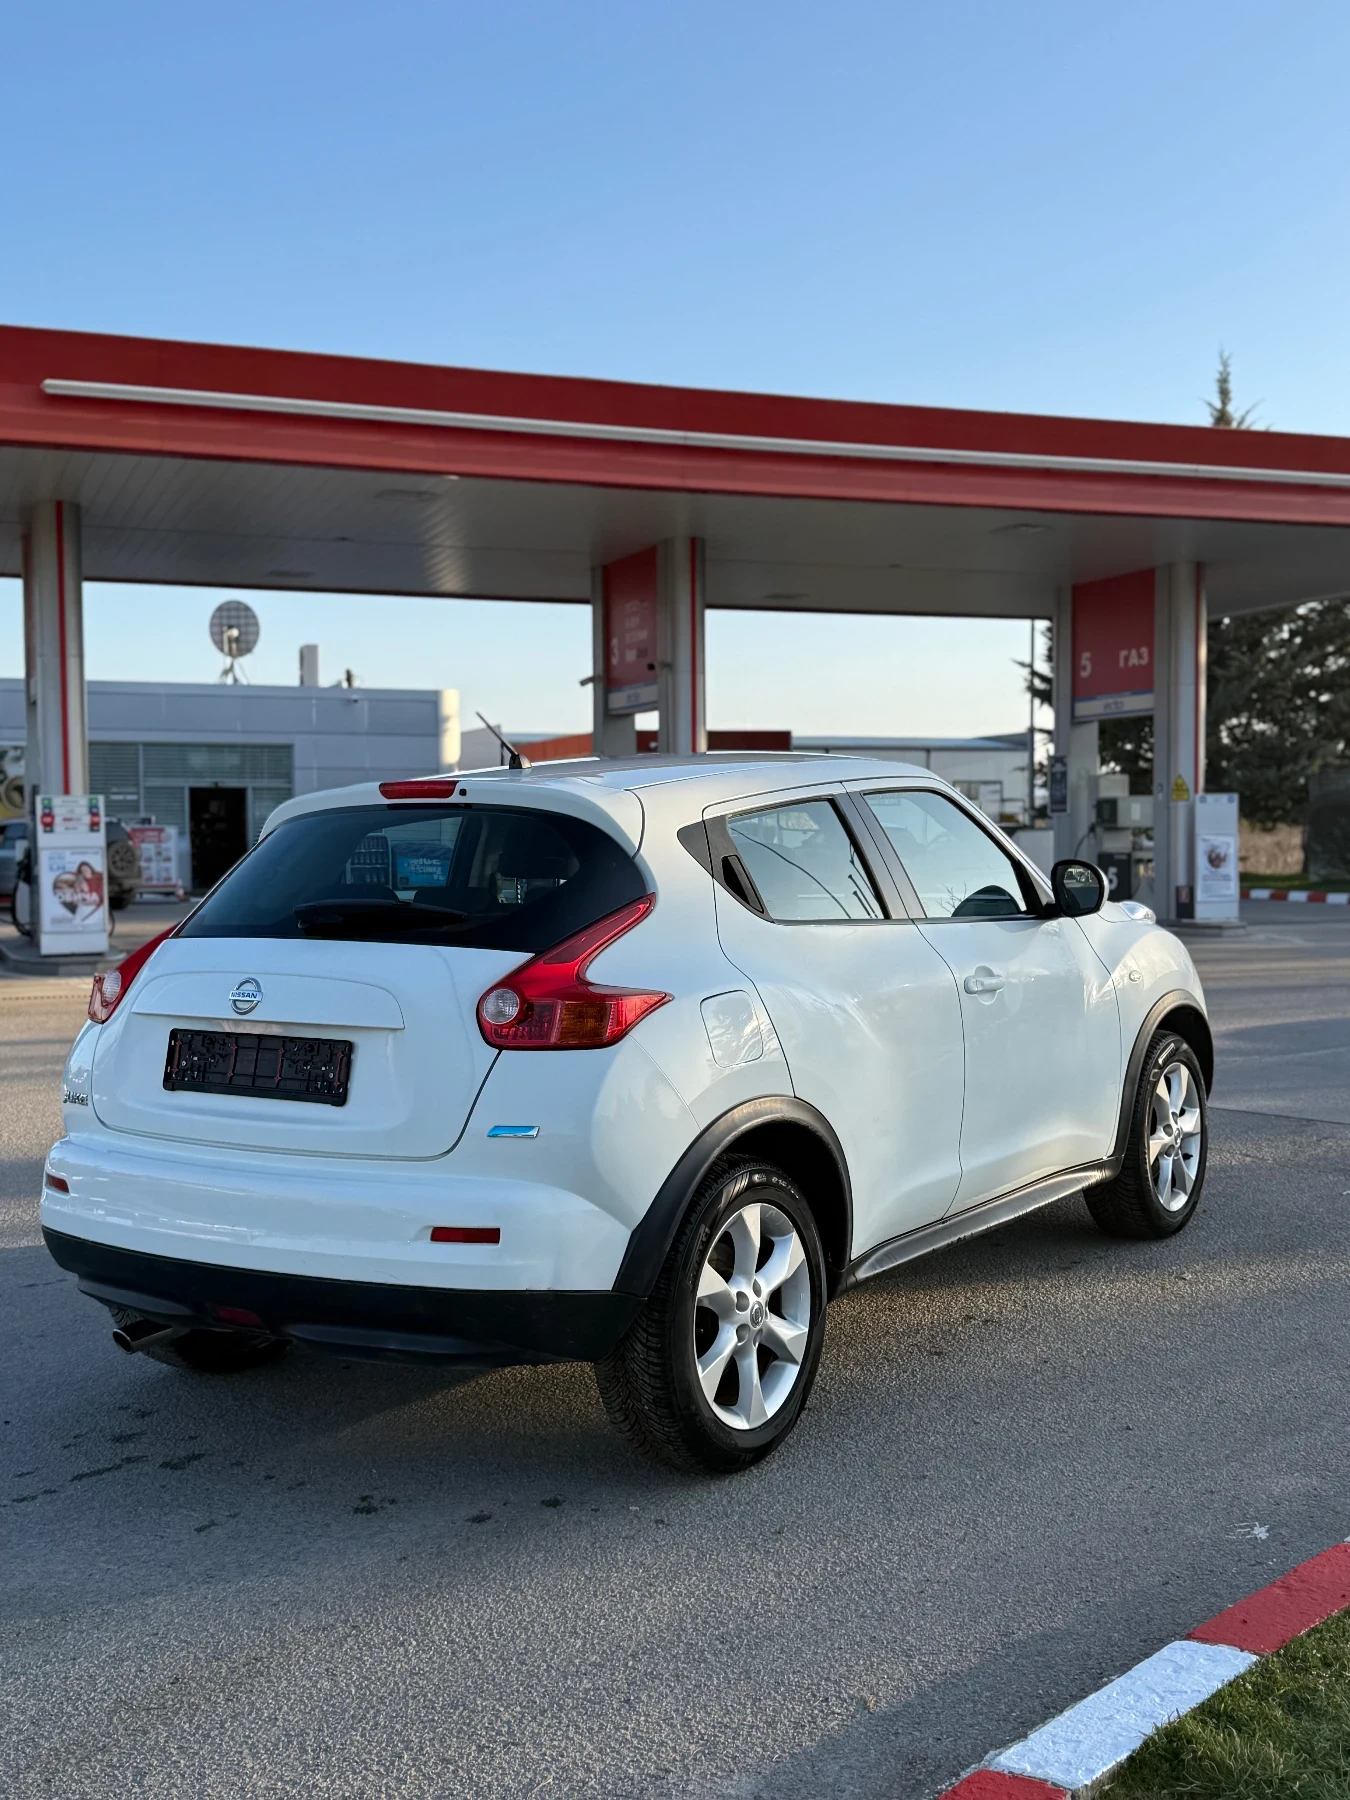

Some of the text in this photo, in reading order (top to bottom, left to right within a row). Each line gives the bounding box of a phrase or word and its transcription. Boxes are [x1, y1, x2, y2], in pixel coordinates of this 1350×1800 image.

[610, 637, 619, 665] 3
[1119, 645, 1149, 668] ГАЗ
[1080, 651, 1092, 678] 5
[1107, 866, 1118, 891] 5
[231, 991, 258, 999] NISSAN
